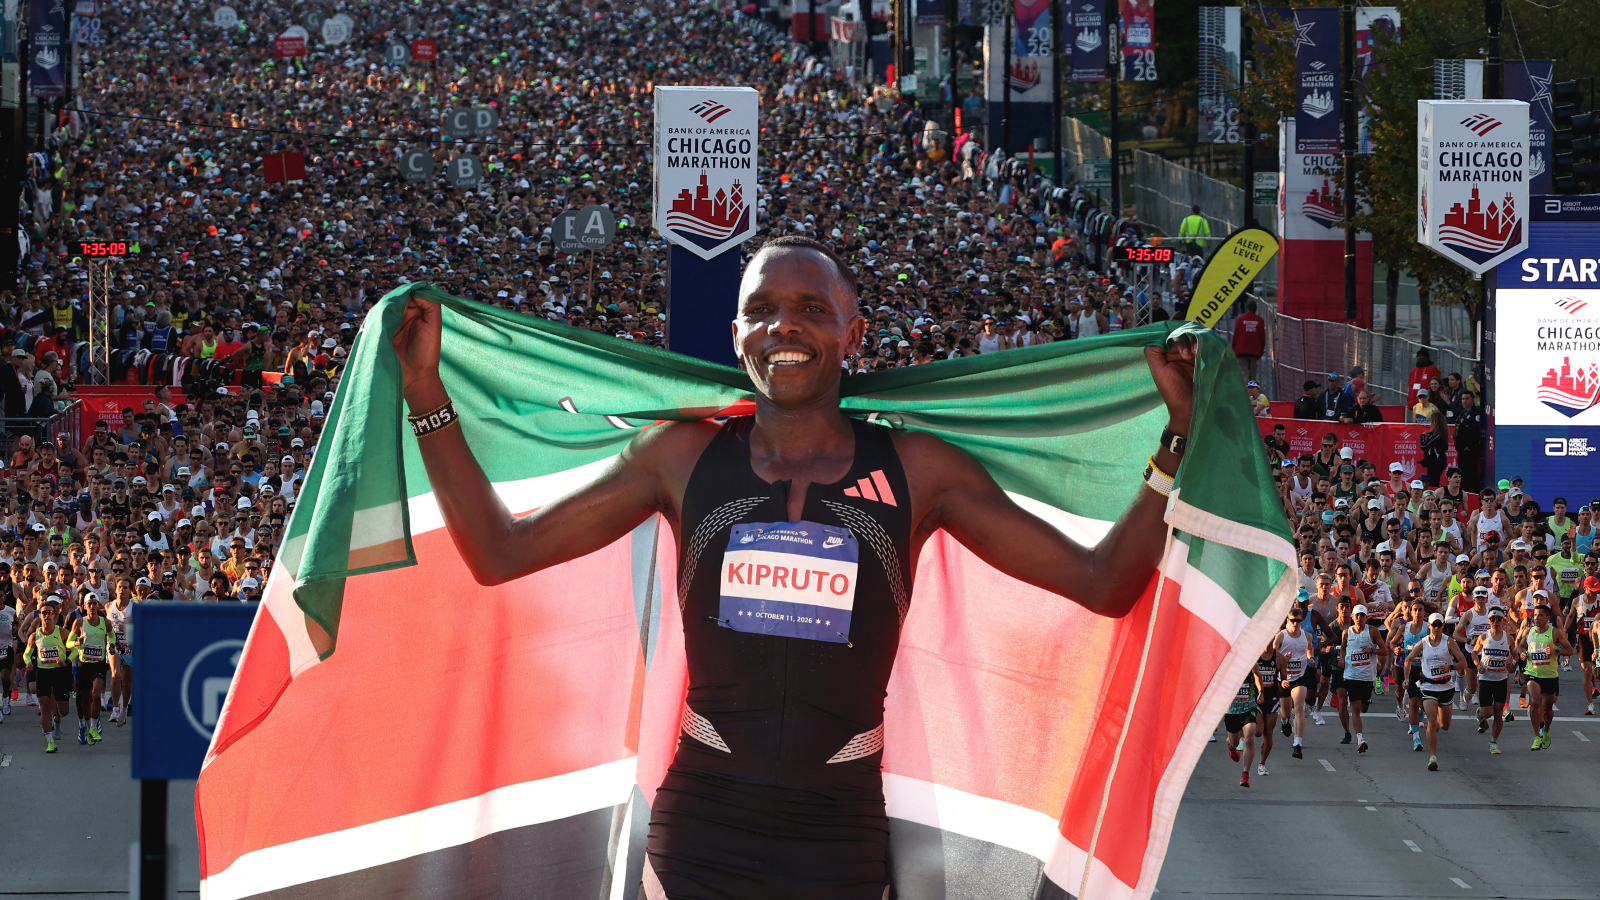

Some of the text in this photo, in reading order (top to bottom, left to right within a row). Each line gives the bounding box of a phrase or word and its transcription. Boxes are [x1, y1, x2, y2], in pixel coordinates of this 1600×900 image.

[80, 17, 101, 30] 20
[80, 30, 101, 43] 26
[1027, 27, 1049, 42] 20
[392, 45, 405, 59] D
[1027, 41, 1050, 57] 26
[1133, 49, 1156, 65] 20
[1133, 65, 1158, 81] 26
[454, 112, 468, 129] C
[477, 110, 492, 128] D
[1213, 126, 1240, 143] 26
[668, 138, 751, 154] CHICAGO
[408, 153, 424, 172] C
[668, 156, 751, 169] MARATHON
[1303, 156, 1339, 166] CHICA
[1439, 152, 1523, 167] CHICAGO
[457, 158, 474, 178] B
[1440, 170, 1522, 182] MARATHON
[584, 210, 605, 234] A
[561, 241, 585, 249] Corra
[581, 235, 605, 244] Corral
[1237, 238, 1264, 253] ALERT
[1233, 247, 1260, 262] LEVEL
[1521, 258, 1600, 282] STAR
[780, 535, 813, 545] MARATHON
[827, 536, 844, 545] RUN
[727, 562, 850, 596] KIPRUTO
[755, 611, 813, 624] OCTOBER 11, 2026
